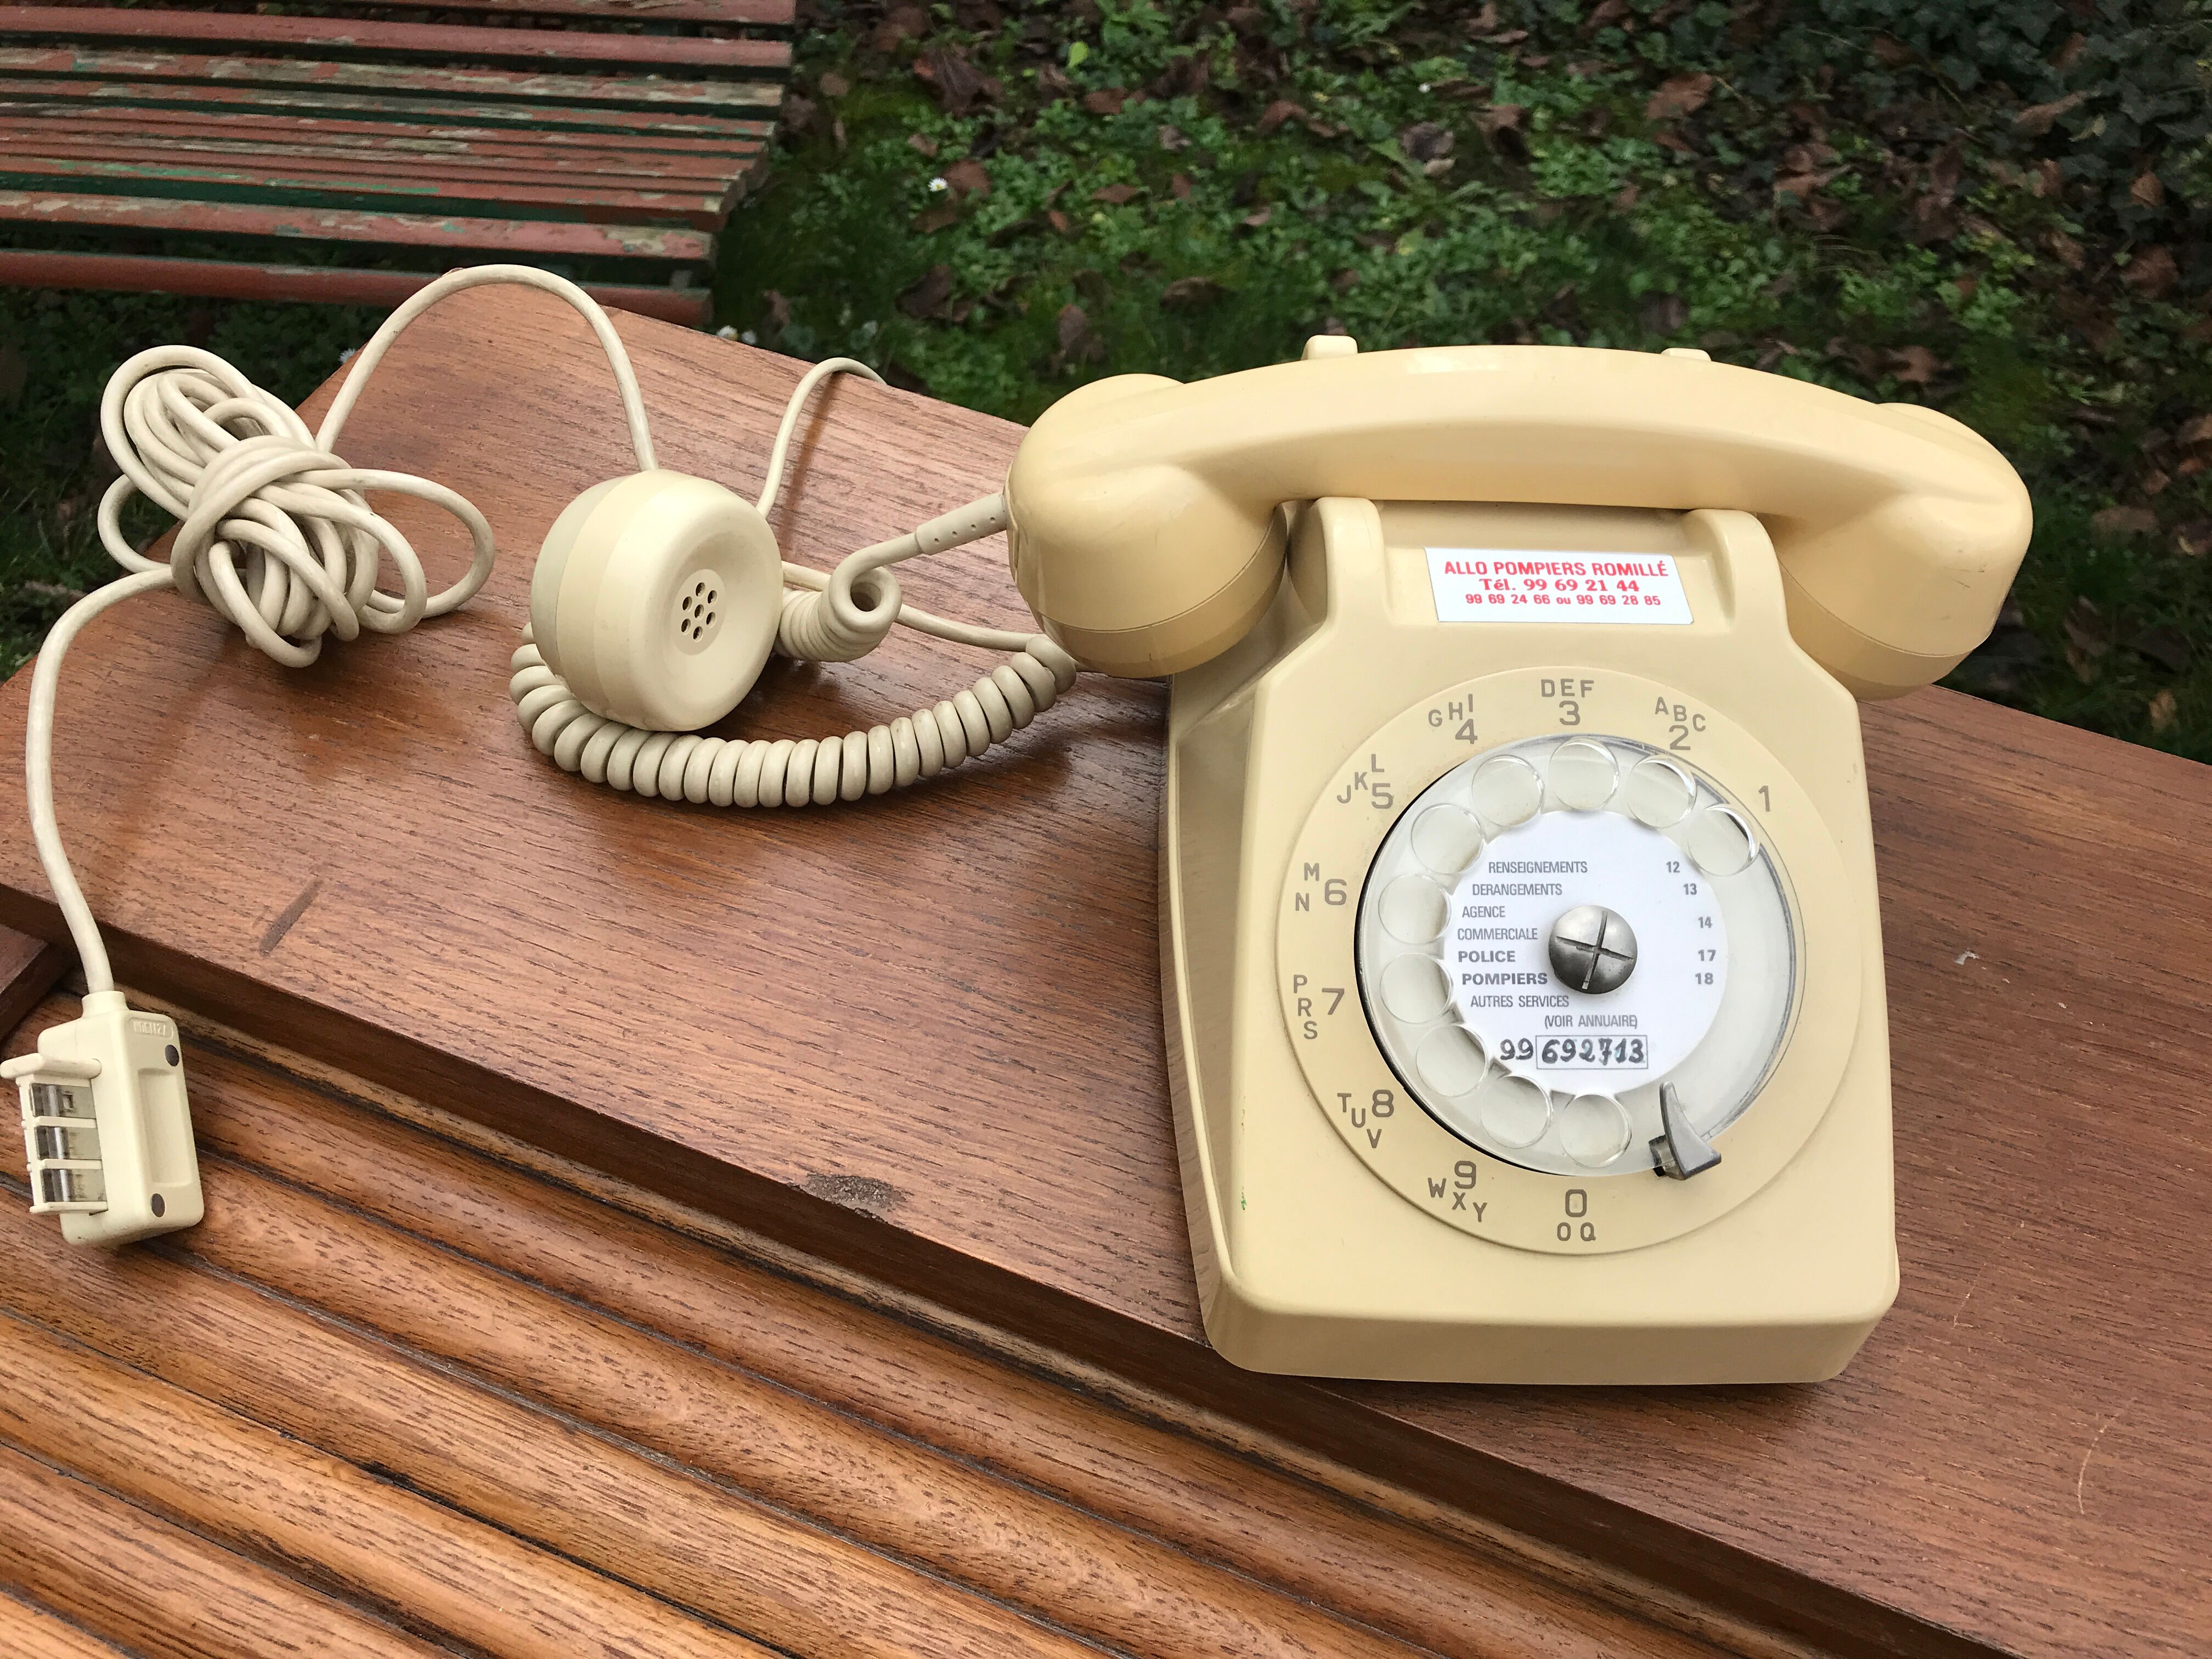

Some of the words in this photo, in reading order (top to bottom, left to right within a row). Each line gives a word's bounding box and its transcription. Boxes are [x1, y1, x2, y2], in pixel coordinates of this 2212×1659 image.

[1444, 561, 1487, 575] ALLO
[1494, 561, 1587, 575] POMPIERS
[1592, 561, 1668, 577] ROMILLÉ
[1480, 578, 1516, 591] Tél.
[1523, 579, 1548, 591] 99
[1554, 579, 1578, 591] 69
[1585, 579, 1607, 591] 21
[1616, 579, 1640, 592] 44
[1465, 594, 1483, 604] 99
[1488, 594, 1505, 604] 69
[1511, 594, 1528, 605] 24
[1533, 594, 1550, 605] 66
[1556, 597, 1571, 605] ou
[1576, 595, 1594, 605] 99
[1599, 595, 1617, 605] 69
[1621, 595, 1639, 605] 28
[1644, 595, 1661, 606] 85
[1541, 678, 1594, 698] DEF
[1559, 700, 1581, 726] 3
[1455, 719, 1478, 744] 4
[1669, 725, 1691, 751] 2
[1371, 783, 1394, 809] 5
[1758, 785, 1770, 812] 1
[1488, 861, 1588, 873] RENSEIGNEMENTS
[1666, 861, 1680, 873] 12
[1324, 878, 1347, 906] 6
[1472, 883, 1562, 896] DERANGEMENTS
[1683, 883, 1697, 895] 13
[1462, 906, 1506, 918] AGENCE
[1698, 916, 1713, 929] 14
[1457, 928, 1538, 940] COMMERCIALE
[1458, 950, 1516, 963] POLICE
[1698, 949, 1717, 962] 17
[1462, 973, 1548, 985] POMPIERS
[1695, 973, 1714, 985] 18
[1322, 988, 1345, 1015] 7
[1470, 995, 1514, 1008] AUTRES
[1519, 995, 1569, 1008] SERVICES
[1544, 1014, 1573, 1029] (VOIR
[1578, 1014, 1638, 1029] ANNUAIRE)
[1499, 1038, 1533, 1060] 99
[1541, 1038, 1644, 1065] 692713
[1372, 1089, 1395, 1118] 8
[1454, 1160, 1477, 1189] 9
[1565, 1189, 1588, 1218] 0
